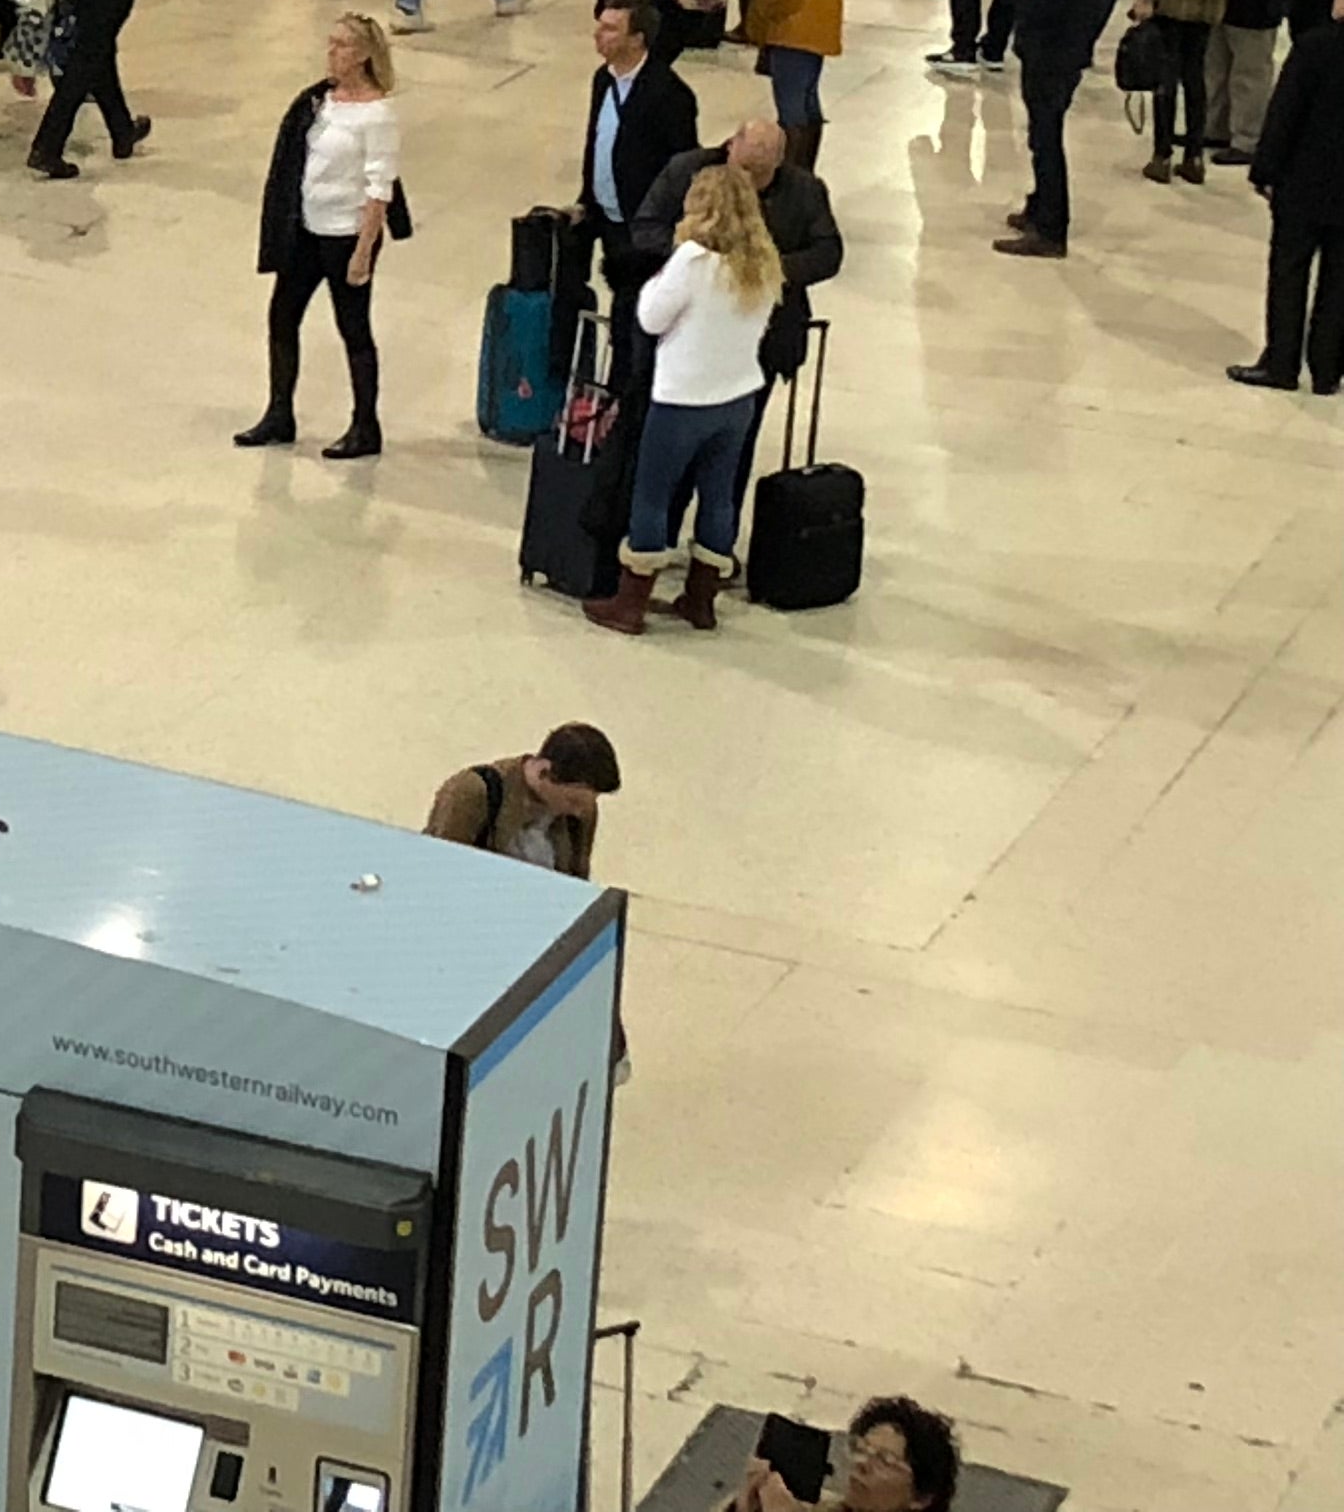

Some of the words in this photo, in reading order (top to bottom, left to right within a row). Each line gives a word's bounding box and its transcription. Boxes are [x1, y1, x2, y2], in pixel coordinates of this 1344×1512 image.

[53, 1036, 398, 1126] www.southwesternrailway.com
[151, 1195, 280, 1247] TICKETS
[478, 1080, 589, 1323] SW
[150, 1233, 197, 1261] Cash
[201, 1249, 239, 1269] and
[243, 1254, 291, 1281] Card
[296, 1266, 397, 1306] Payments
[518, 1268, 563, 1438] R
